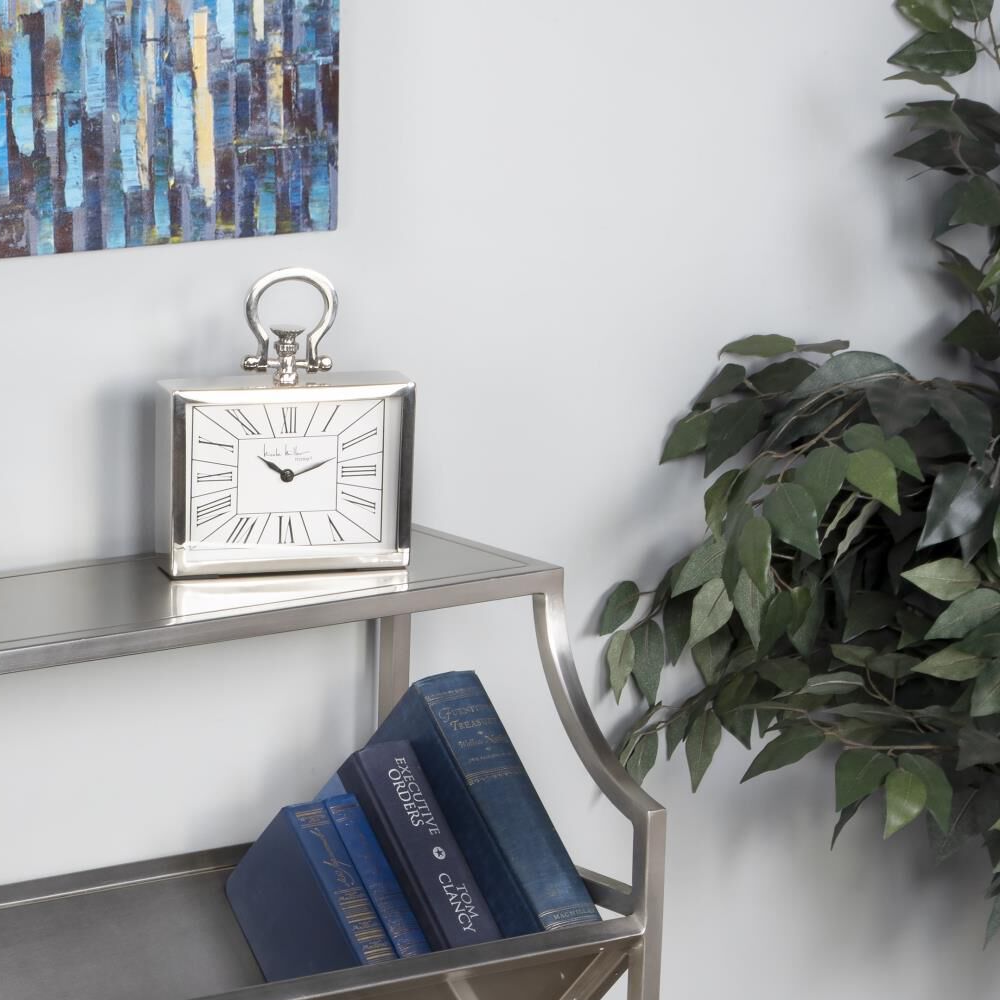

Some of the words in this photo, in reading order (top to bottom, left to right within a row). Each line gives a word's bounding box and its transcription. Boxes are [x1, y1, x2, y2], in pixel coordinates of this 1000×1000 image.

[281, 406, 298, 434] XII
[388, 768, 424, 827] ORDERS
[394, 757, 440, 836] EXECUTIVE
[438, 872, 477, 934] CLANCY
[456, 883, 480, 919] TOM
